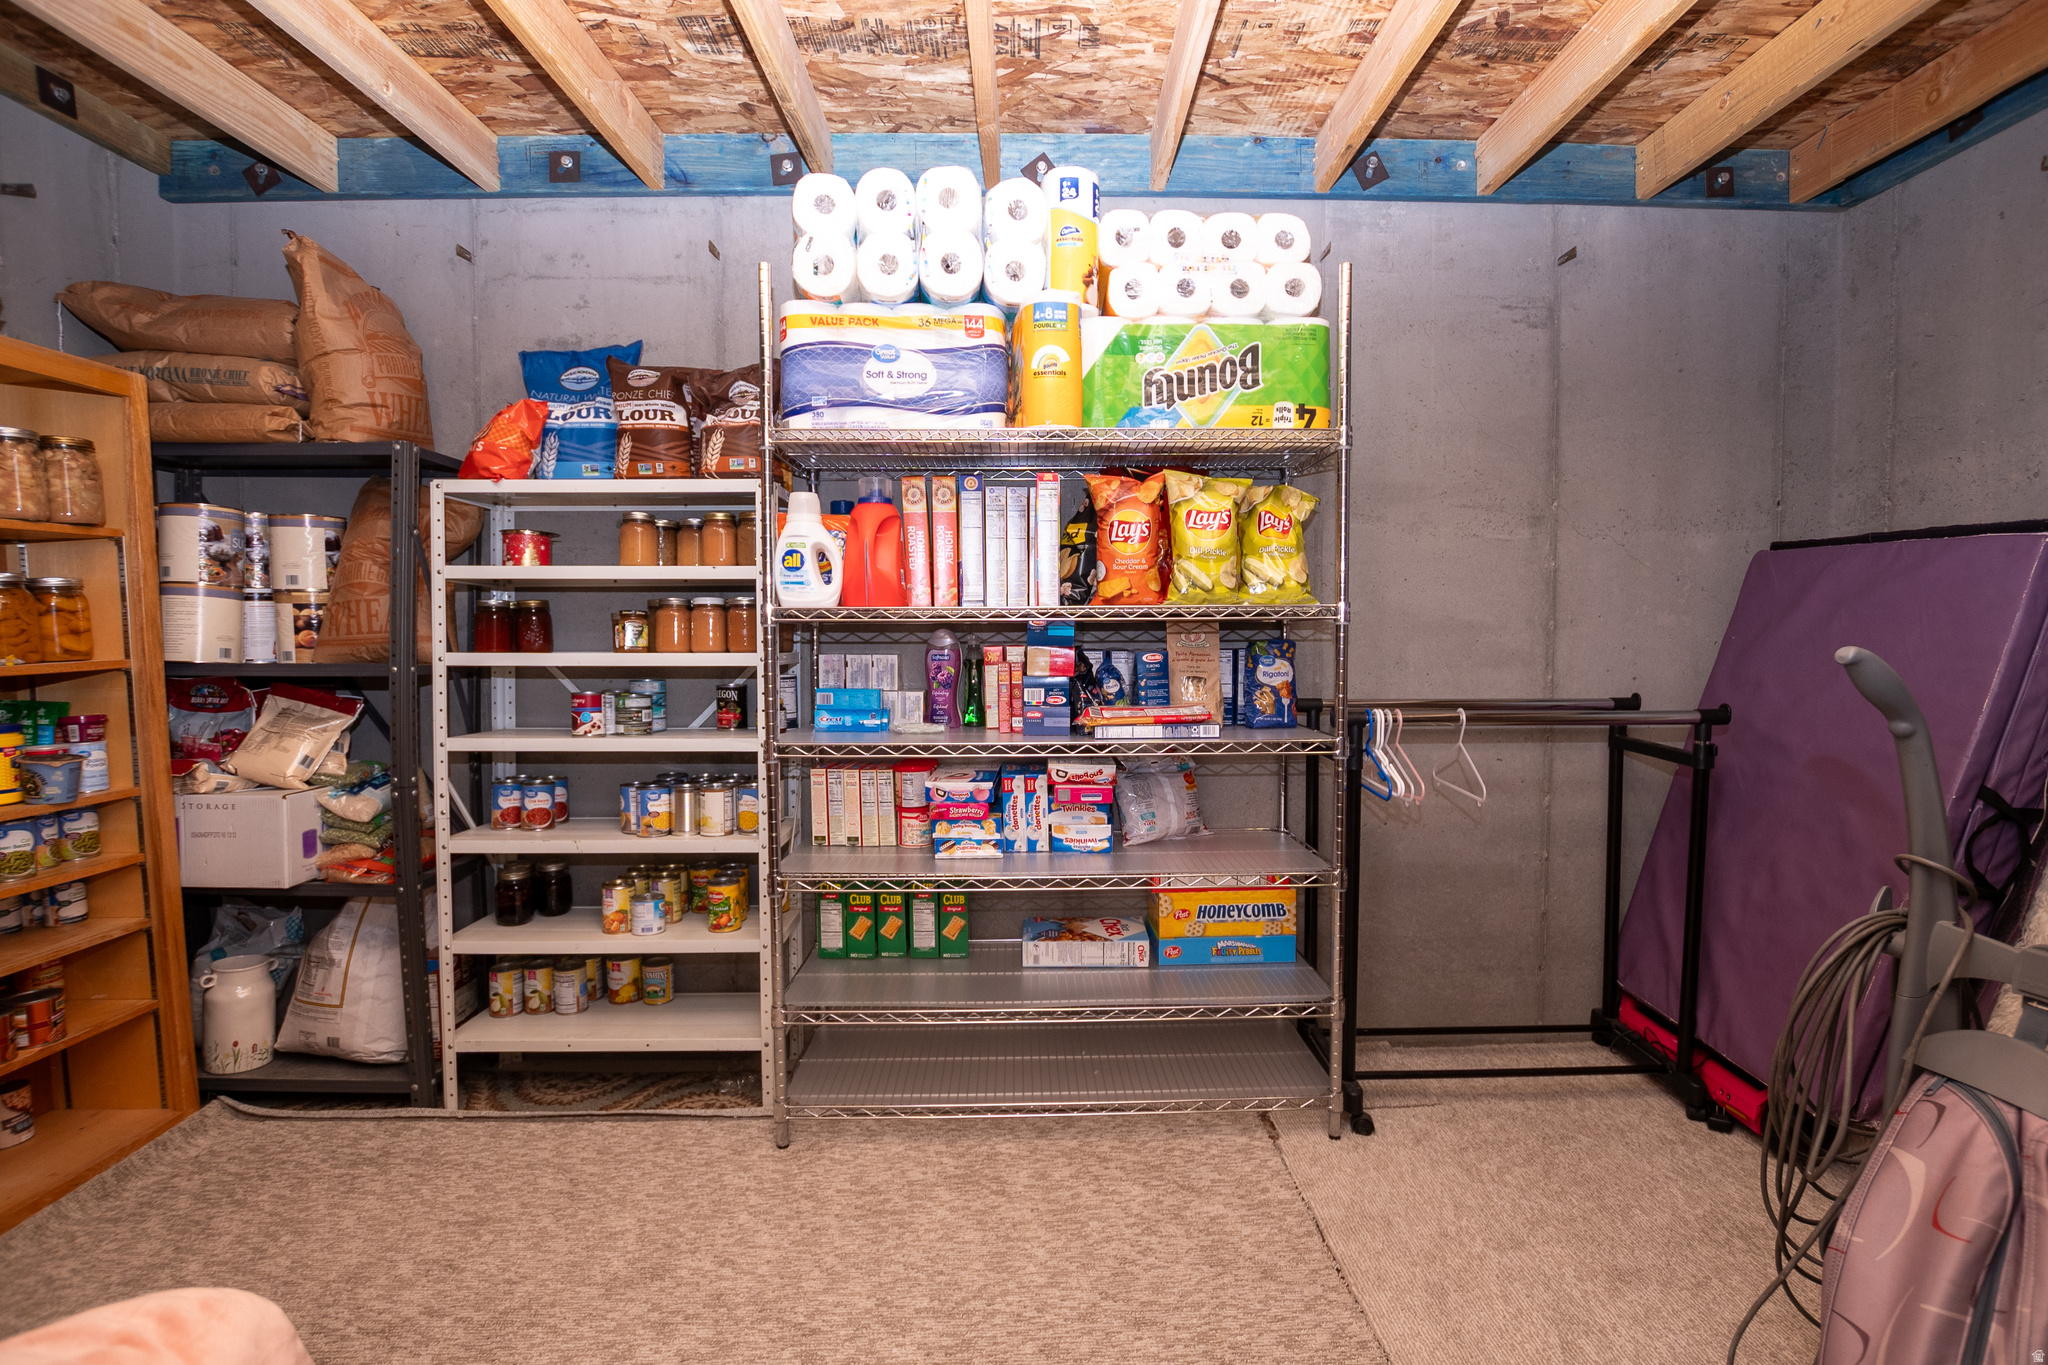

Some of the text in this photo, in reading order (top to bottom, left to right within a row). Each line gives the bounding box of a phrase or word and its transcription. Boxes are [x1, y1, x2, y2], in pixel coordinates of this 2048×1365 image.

[1061, 187, 1078, 199] 24
[810, 316, 880, 327] VALUE PACK
[918, 317, 957, 327] 36 MEGA
[965, 318, 984, 329] 144
[875, 348, 896, 356] Great
[189, 368, 222, 380] BRONZE
[223, 369, 249, 380] CHIEF
[866, 370, 928, 381] Soft & Strong
[1143, 342, 1262, 410] Bounty
[530, 389, 580, 403] NATURAL
[612, 389, 643, 400] RONZE
[366, 391, 431, 437] WHEA
[547, 406, 612, 422] LOUR
[618, 409, 676, 422] LOUR
[1275, 406, 1291, 414] Rolls
[1295, 403, 1317, 428] 4
[1251, 415, 1264, 426] 12
[1274, 415, 1292, 423] Triple
[1187, 508, 1231, 531] Lay's
[1260, 510, 1290, 532] Lay's
[1111, 520, 1150, 544] Lay's
[907, 525, 917, 570] ROASTED
[916, 530, 926, 565] HONEY
[936, 525, 946, 570] ROASTED
[945, 530, 954, 565] HONEY
[1189, 546, 1227, 557] Dill Pickle
[1258, 545, 1296, 554] Dill Pickle
[783, 553, 801, 567] all
[1262, 670, 1290, 679] Rigatoni
[181, 802, 237, 811] STORAGE
[949, 805, 985, 817] Strawberry
[1061, 804, 1097, 813] Twinkies
[1010, 795, 1020, 831] donettes
[1033, 795, 1043, 831] donettes
[850, 893, 872, 905] CLUB
[880, 893, 902, 905] CLUB
[943, 893, 965, 905] CLUB
[1175, 910, 1189, 919] Post
[1196, 903, 1287, 919] HONEYCOMB
[1099, 918, 1124, 937] Chex
[1137, 944, 1145, 962] Chex
[1165, 947, 1179, 956] Post
[1211, 947, 1262, 956] FRUITY PEBBLES
